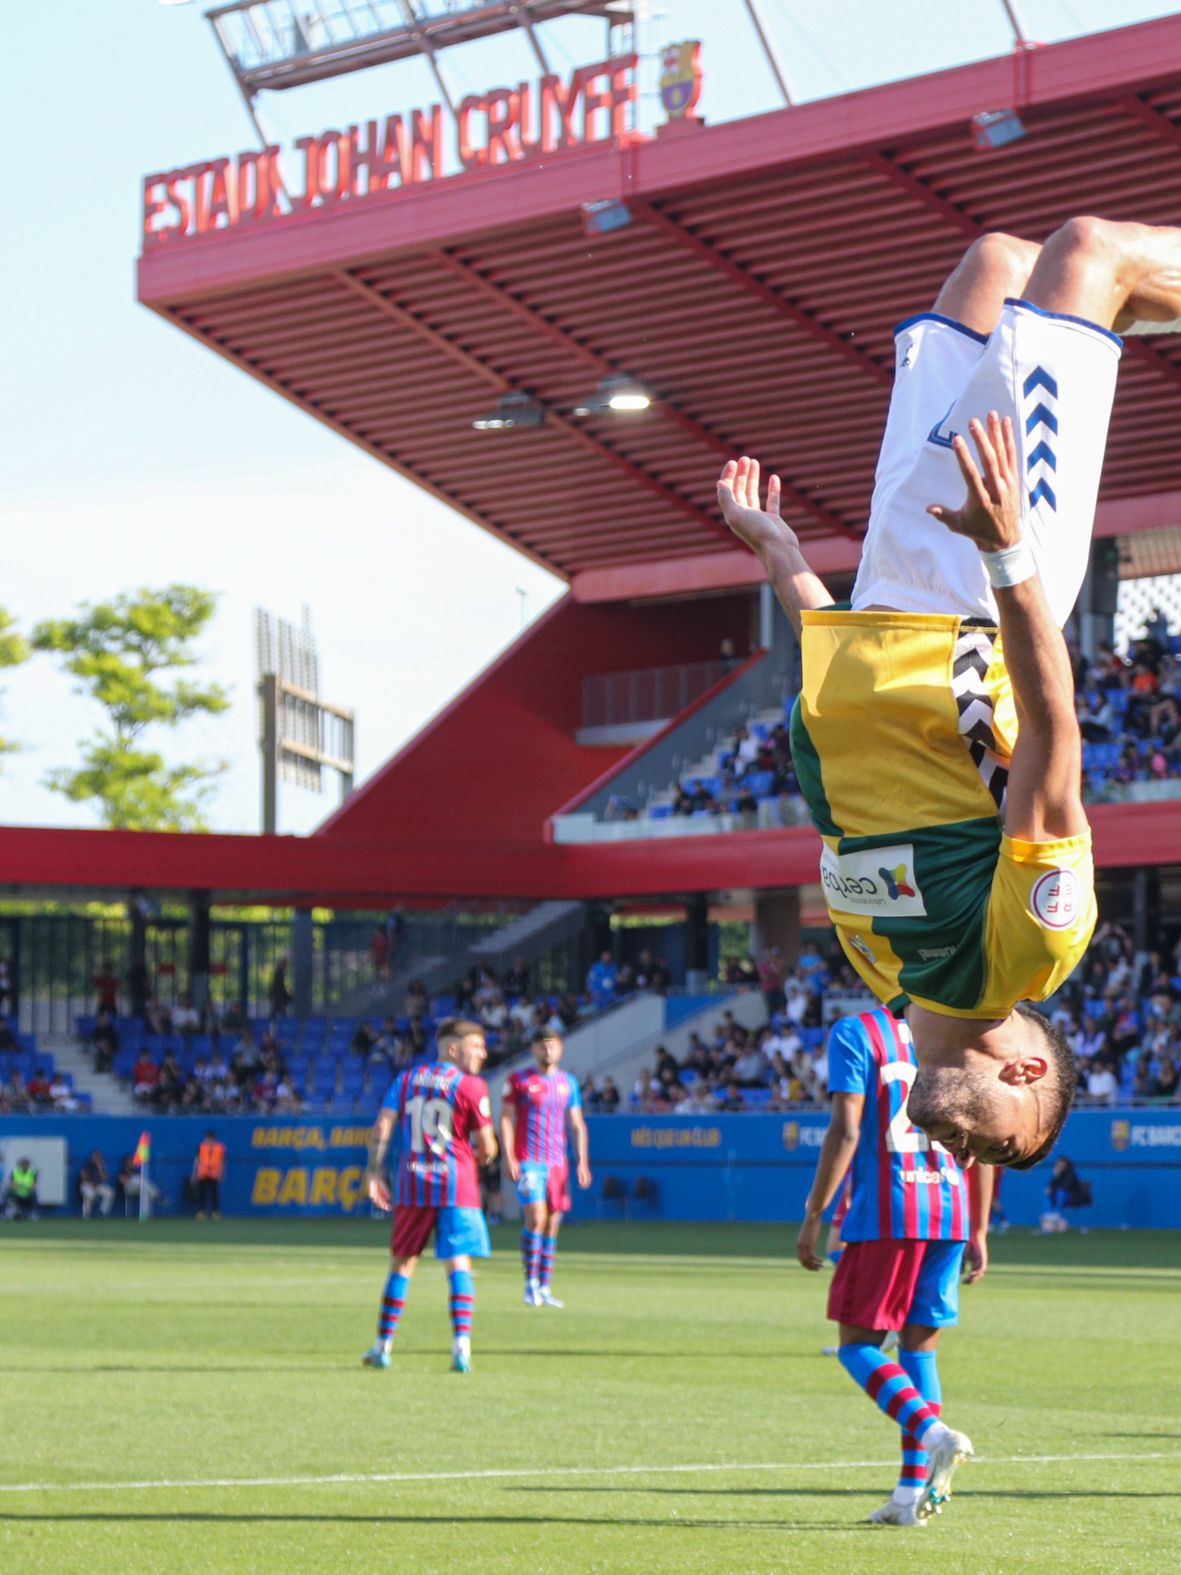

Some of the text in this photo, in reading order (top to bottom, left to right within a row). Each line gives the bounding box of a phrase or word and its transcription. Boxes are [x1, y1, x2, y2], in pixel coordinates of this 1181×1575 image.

[296, 104, 442, 208] JOHAN
[456, 53, 639, 168] CRUYFF
[822, 866, 877, 899] cerba
[405, 1095, 453, 1152] 19
